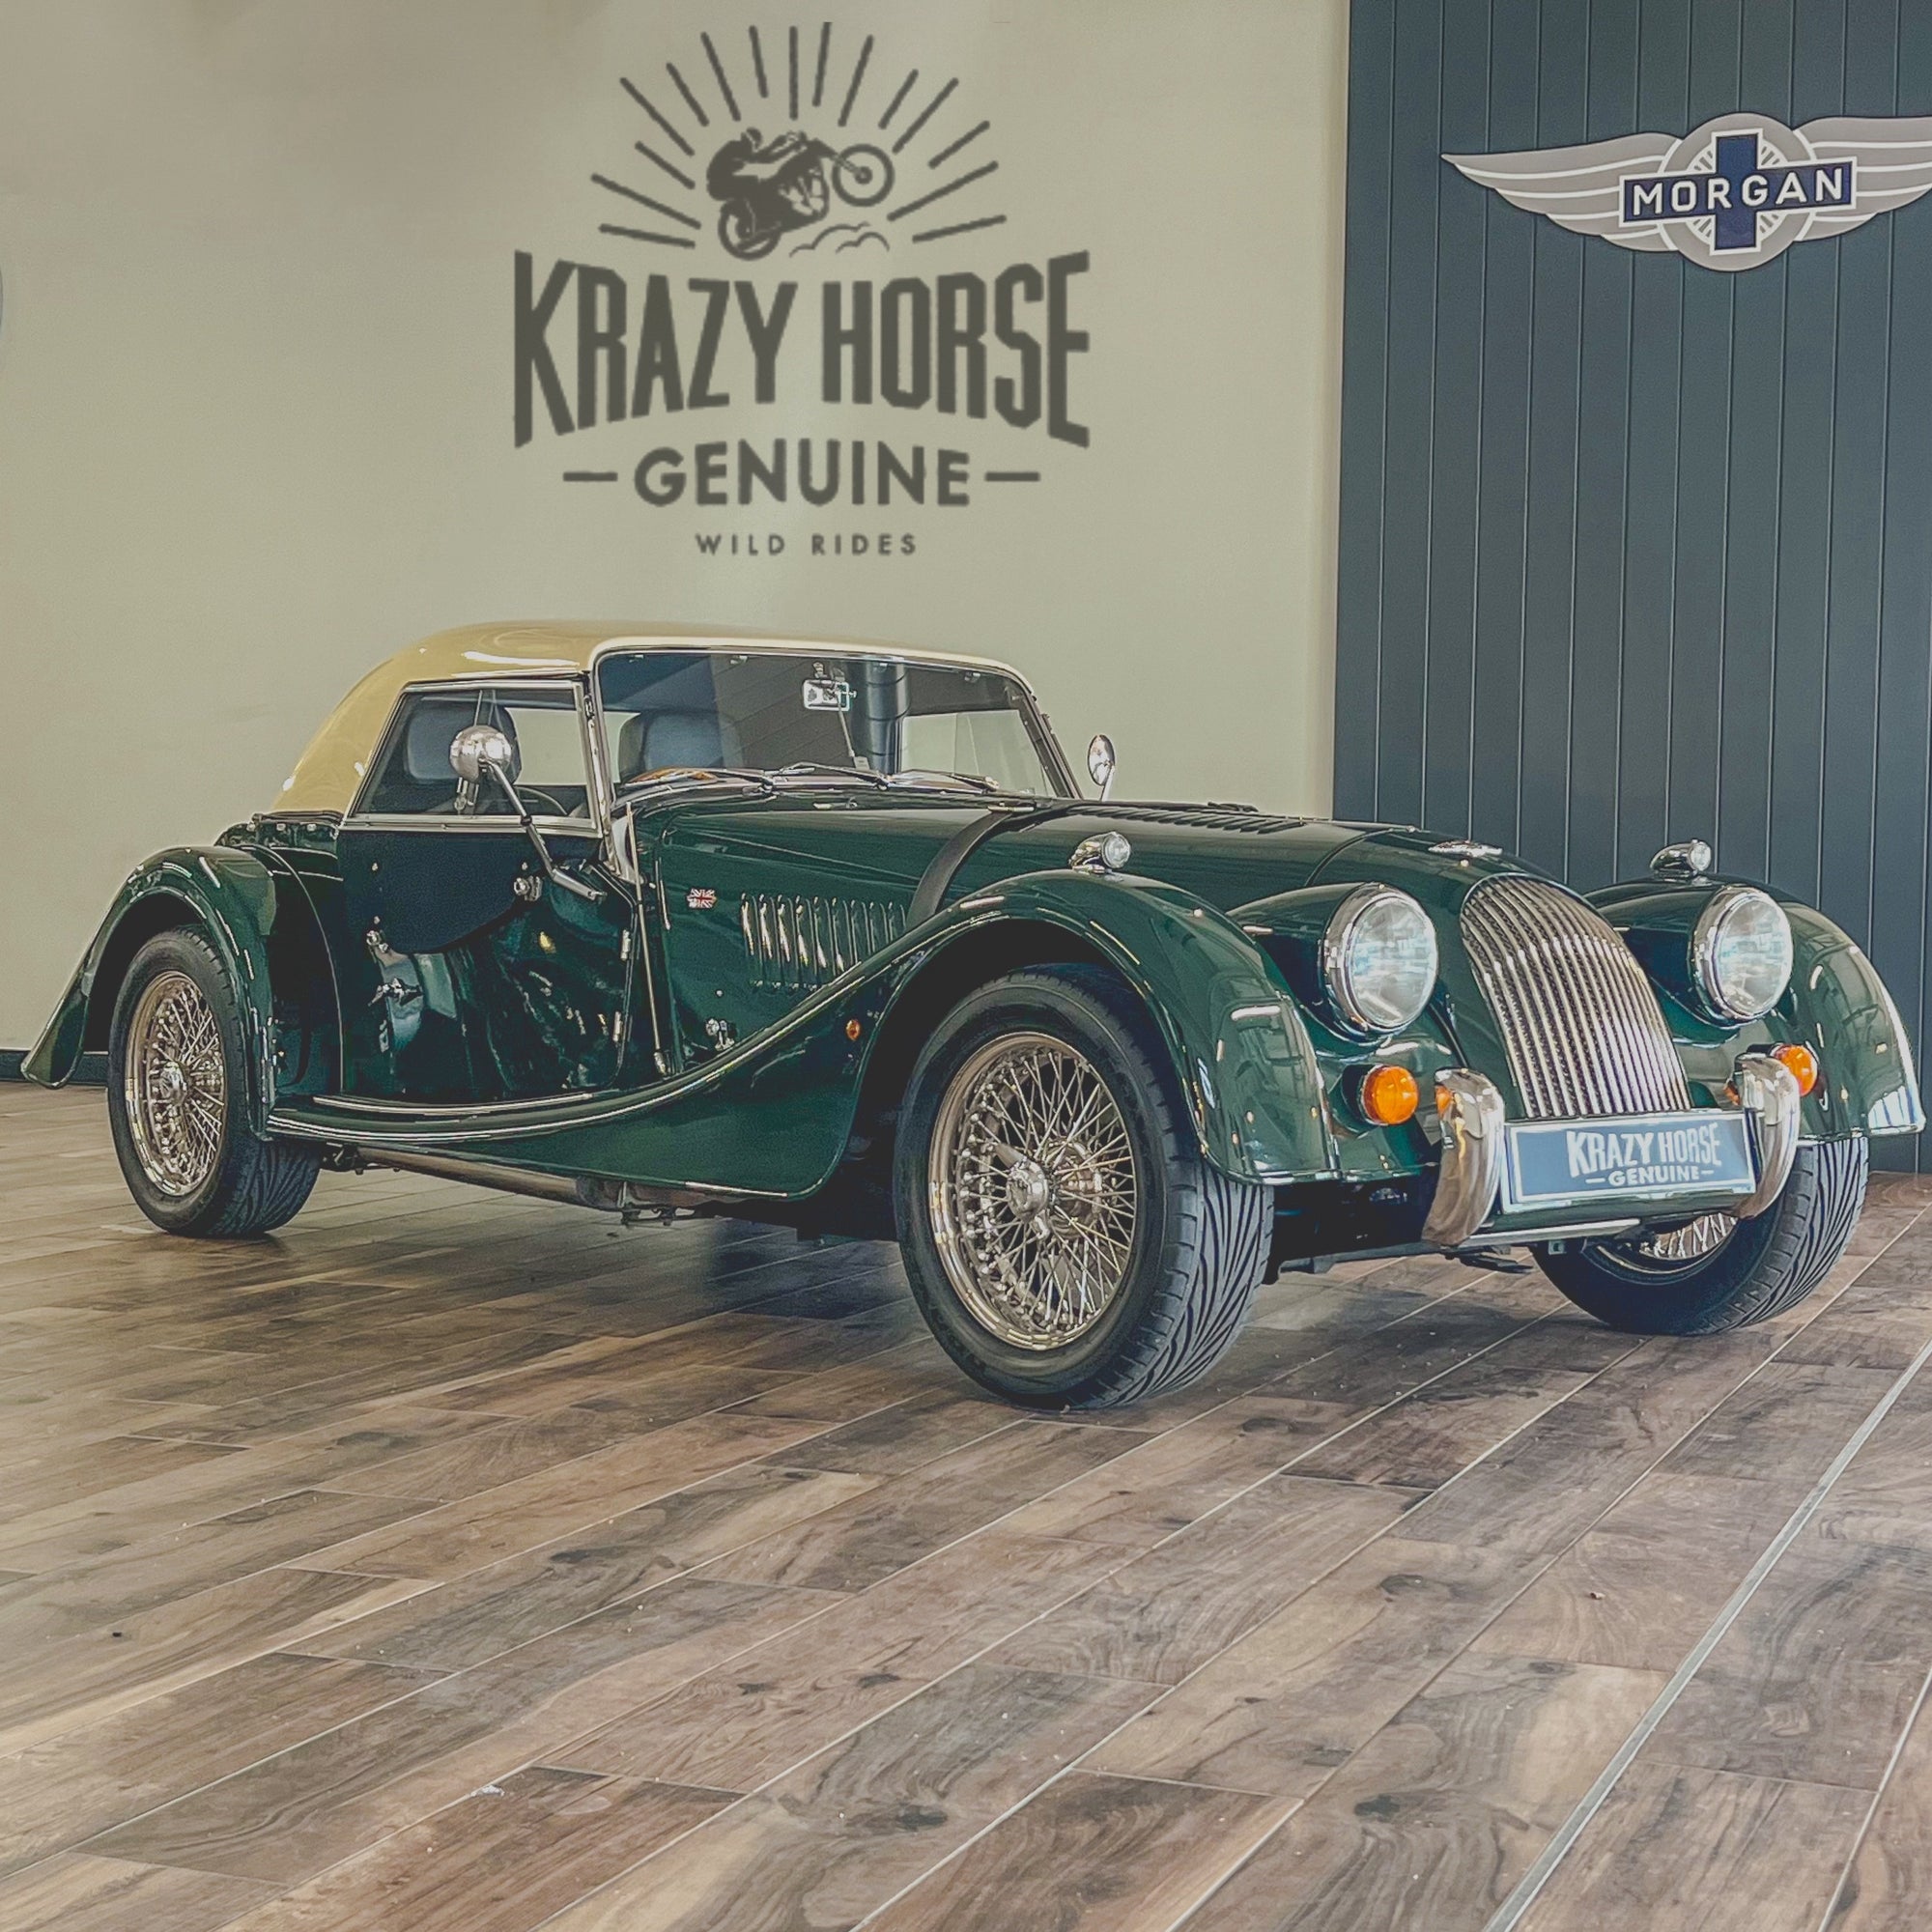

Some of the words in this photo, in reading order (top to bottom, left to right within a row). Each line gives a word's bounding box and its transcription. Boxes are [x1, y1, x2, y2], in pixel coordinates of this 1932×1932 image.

[1633, 168, 1842, 215] MORGAN
[514, 249, 798, 450] KRAZY
[822, 249, 1091, 449] HORSE
[633, 437, 970, 507] GENUINE
[695, 532, 785, 556] WILD
[810, 532, 918, 556] RIDES
[1565, 1129, 1655, 1179] KRAZY
[1659, 1122, 1721, 1167] HORSE
[1607, 1164, 1700, 1187] GENUINE
